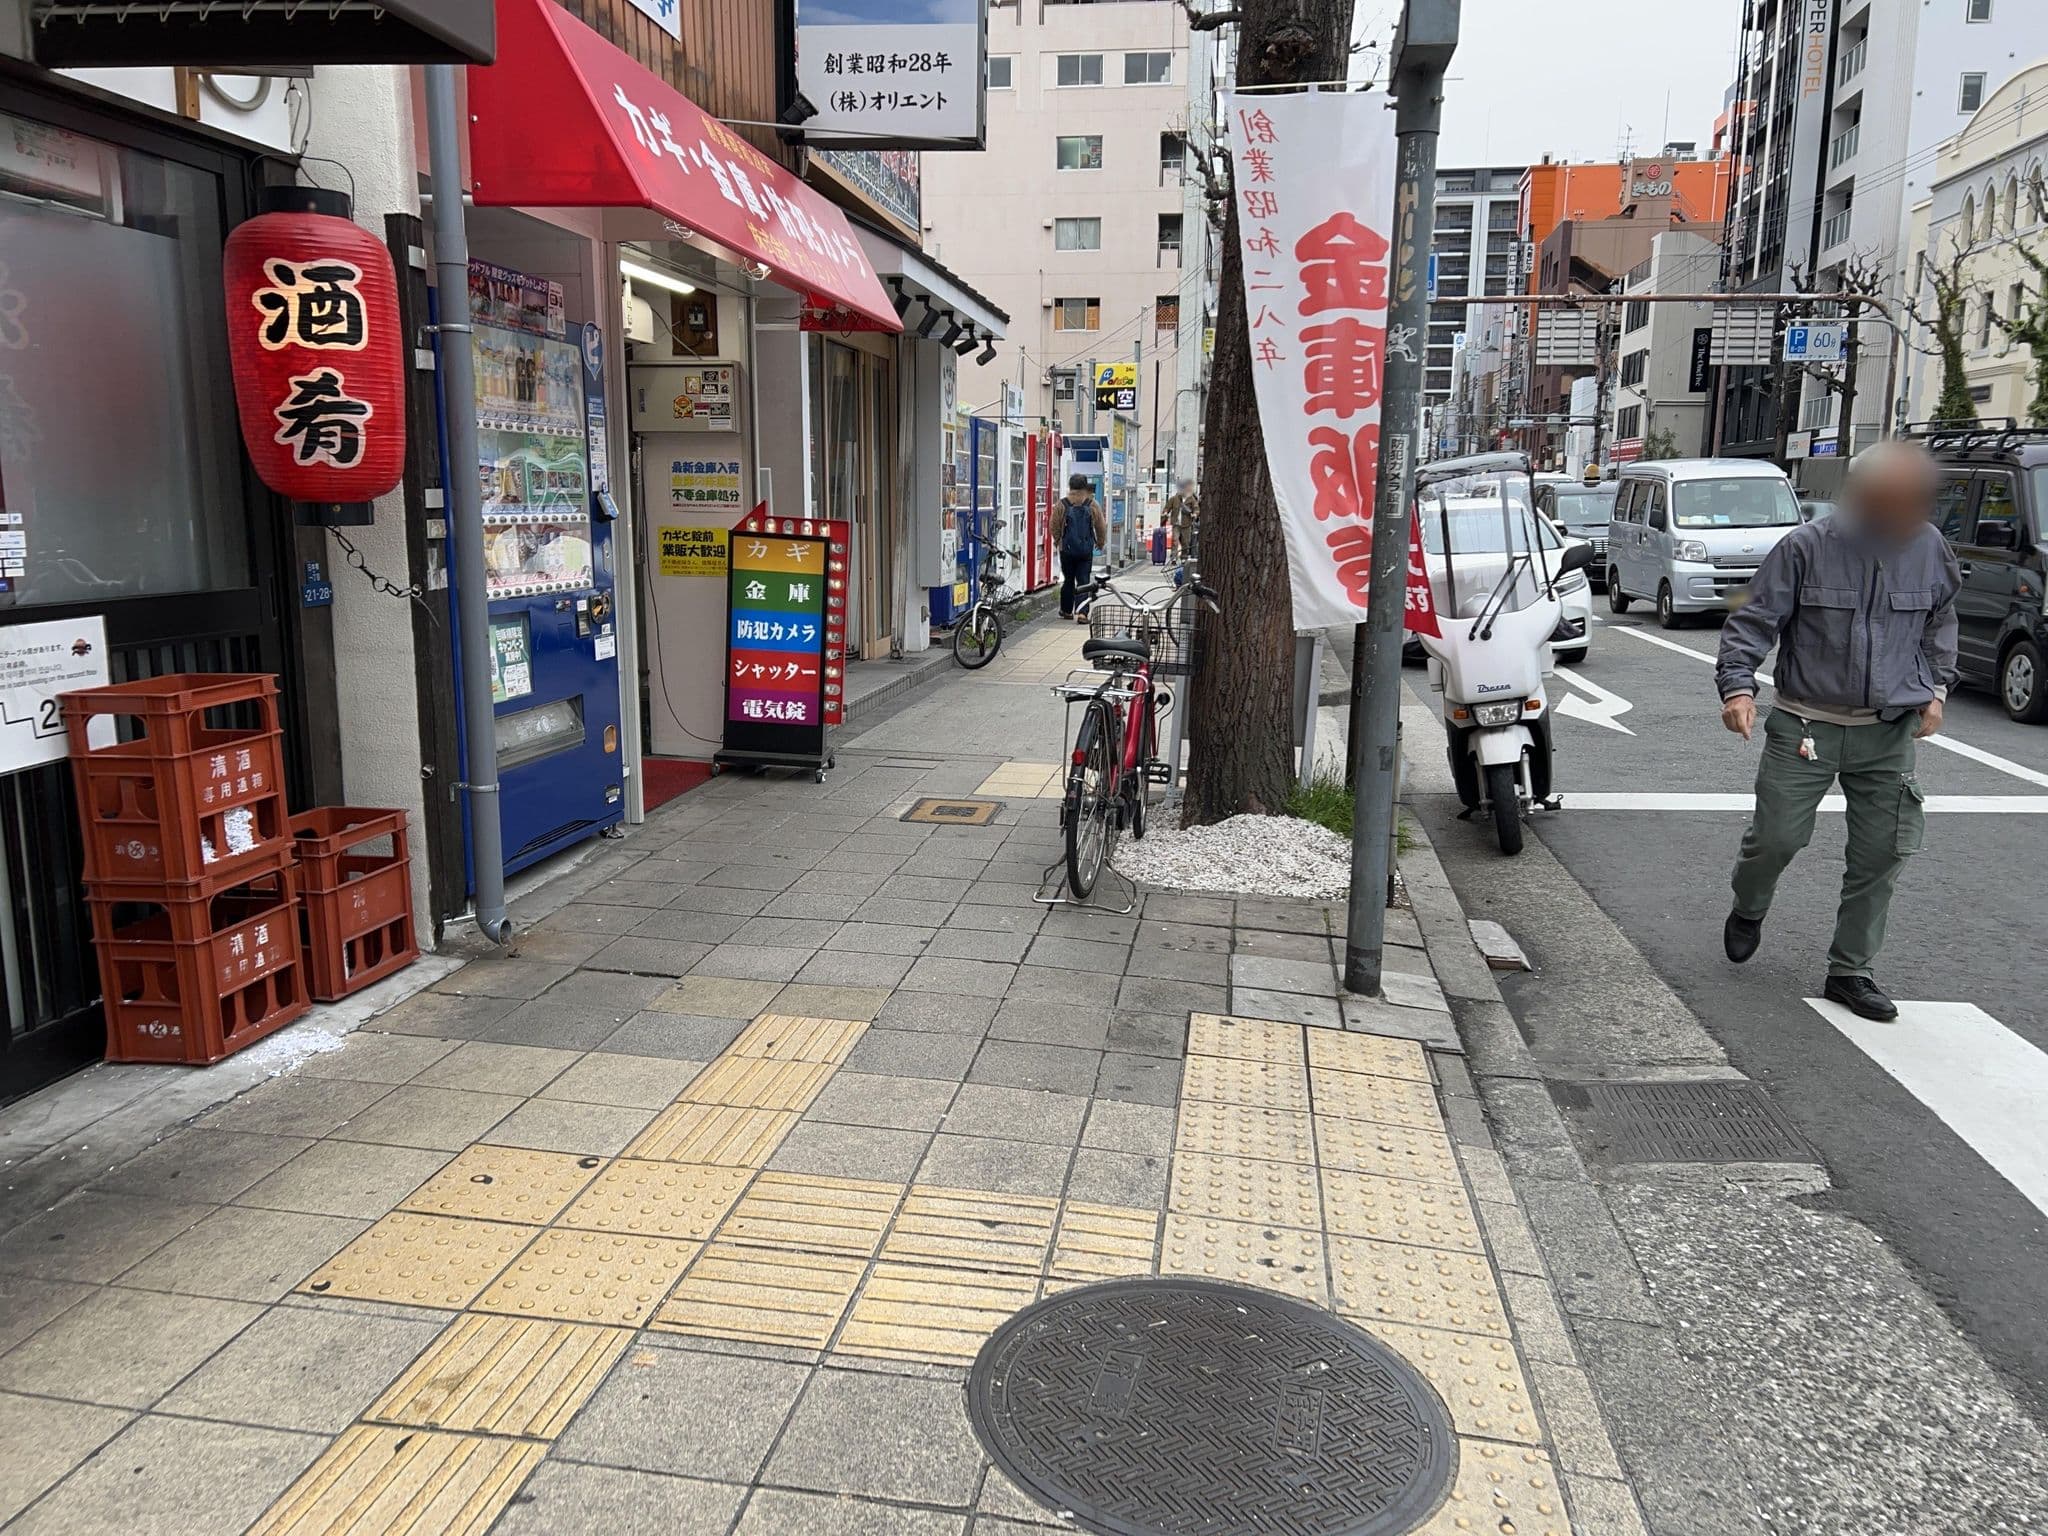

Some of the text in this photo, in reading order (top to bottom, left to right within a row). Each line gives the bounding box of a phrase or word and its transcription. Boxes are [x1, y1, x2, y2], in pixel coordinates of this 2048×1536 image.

[824, 52, 952, 75] 創業昭和28年
[830, 90, 947, 112] (株)オリエント
[1632, 181, 1672, 197] きもの
[1795, 331, 1805, 345] P
[1814, 332, 1836, 348] 60分
[255, 259, 371, 467] 酒肴
[1117, 389, 1134, 408] 空
[672, 461, 739, 474] 最新金庫入荷
[672, 488, 740, 502] 不要金庫処分
[662, 531, 713, 543] カギと錠前
[662, 544, 726, 558] 業販大歓迎
[747, 541, 810, 562] カギ
[745, 580, 810, 603] 金庫
[737, 620, 816, 643] 防犯カメラ
[735, 660, 816, 681] シャッター
[742, 699, 806, 721] 電気錠
[210, 748, 251, 779] 清酒
[230, 923, 269, 957] 清酒
